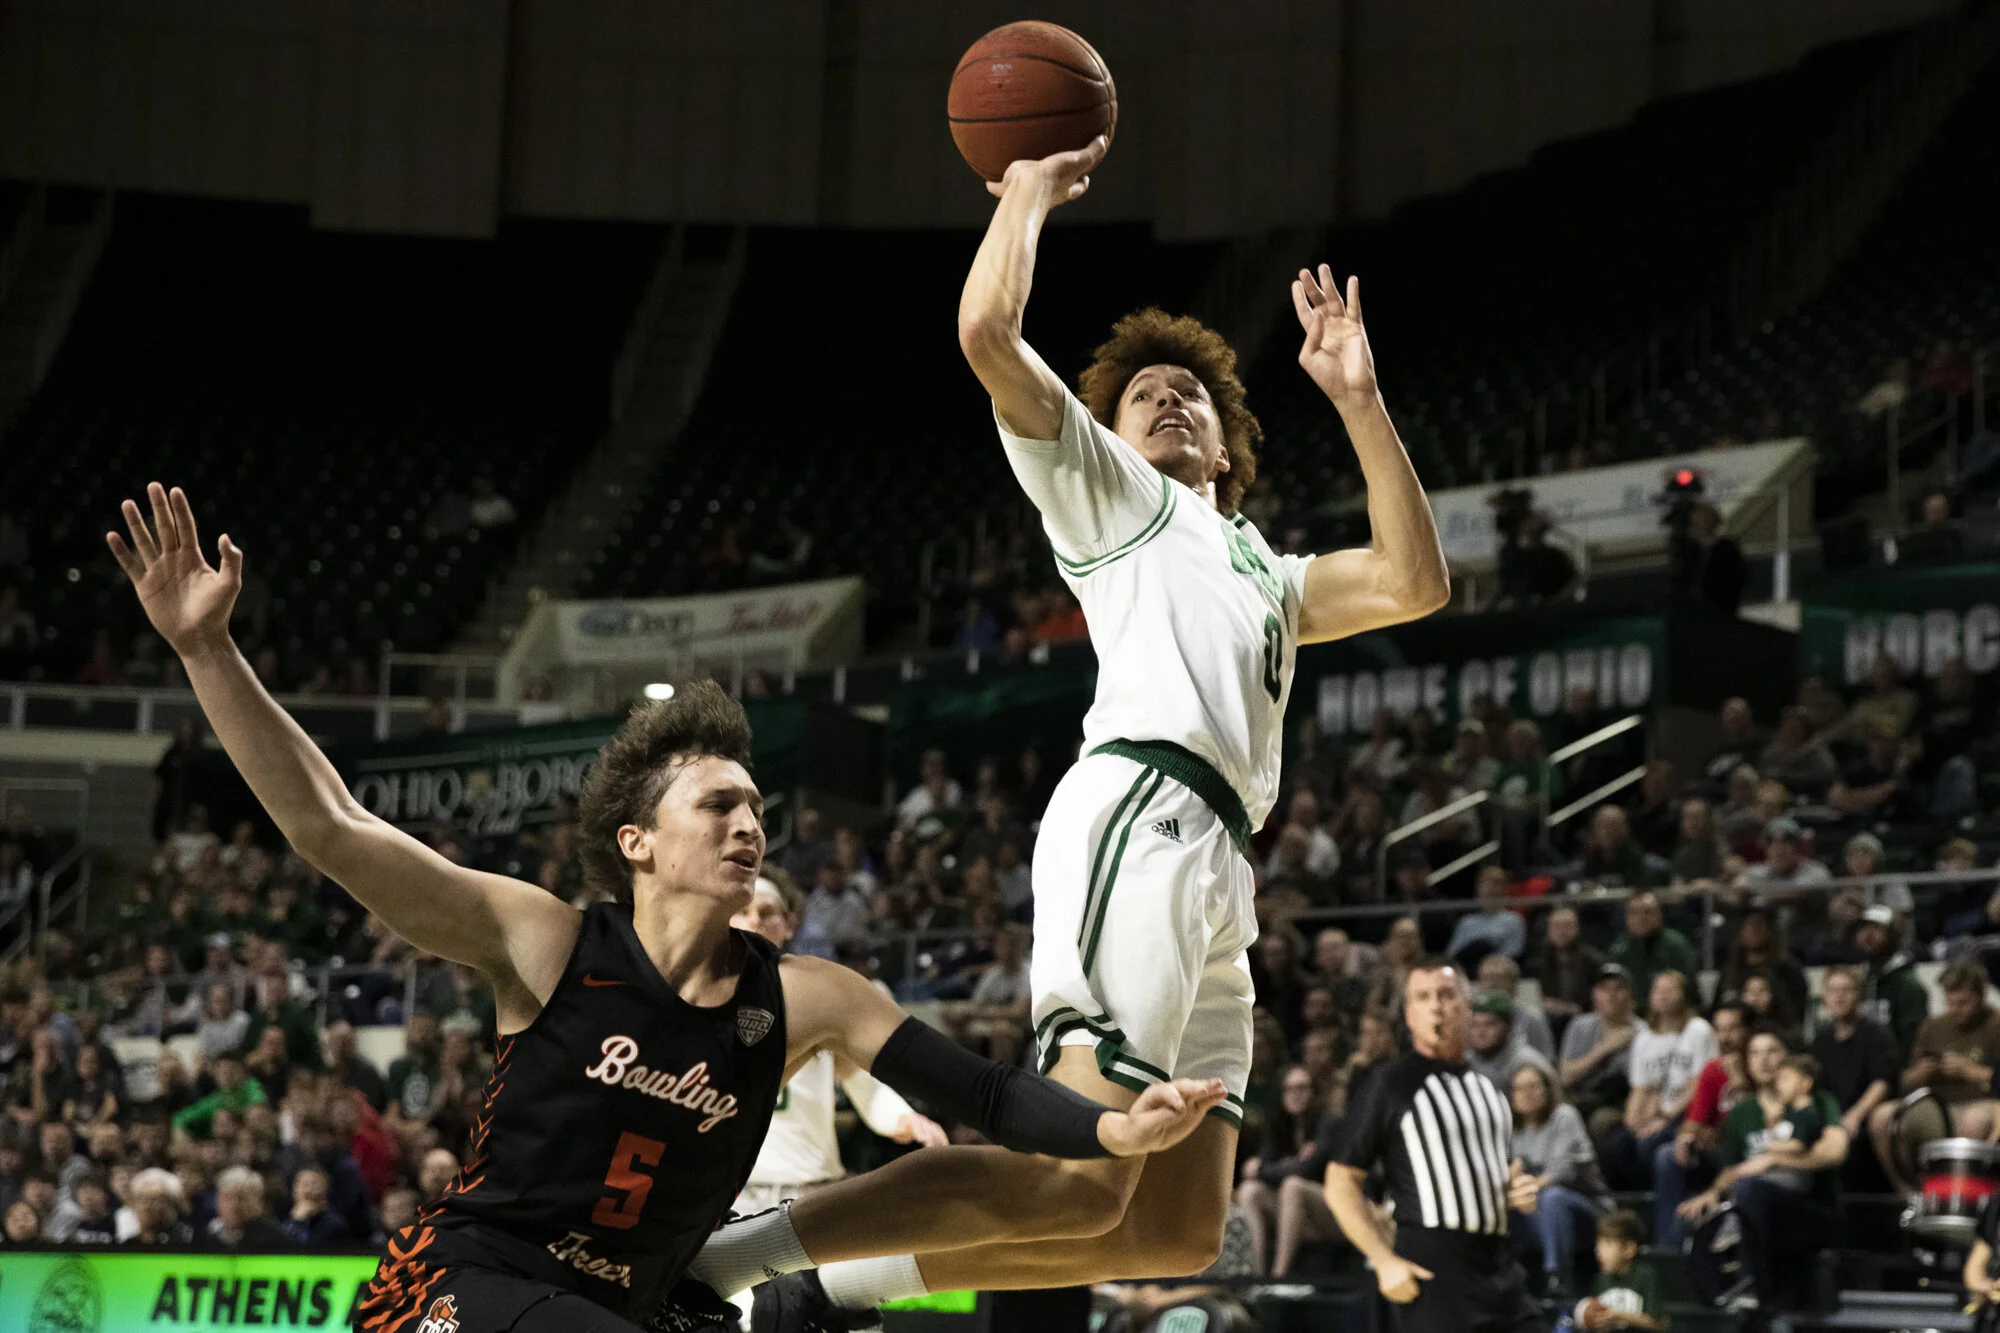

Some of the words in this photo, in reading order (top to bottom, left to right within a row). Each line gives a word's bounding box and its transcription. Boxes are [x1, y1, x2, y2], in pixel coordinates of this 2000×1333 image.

[1264, 610, 1282, 704] 0
[1317, 662, 1448, 735] HOME
[1459, 656, 1519, 718] OF
[1530, 642, 1652, 716] OHIO
[353, 766, 463, 820] OHIO
[585, 1035, 738, 1133] Bowling
[592, 1131, 666, 1230] 5
[151, 1277, 333, 1326] ATHENS
